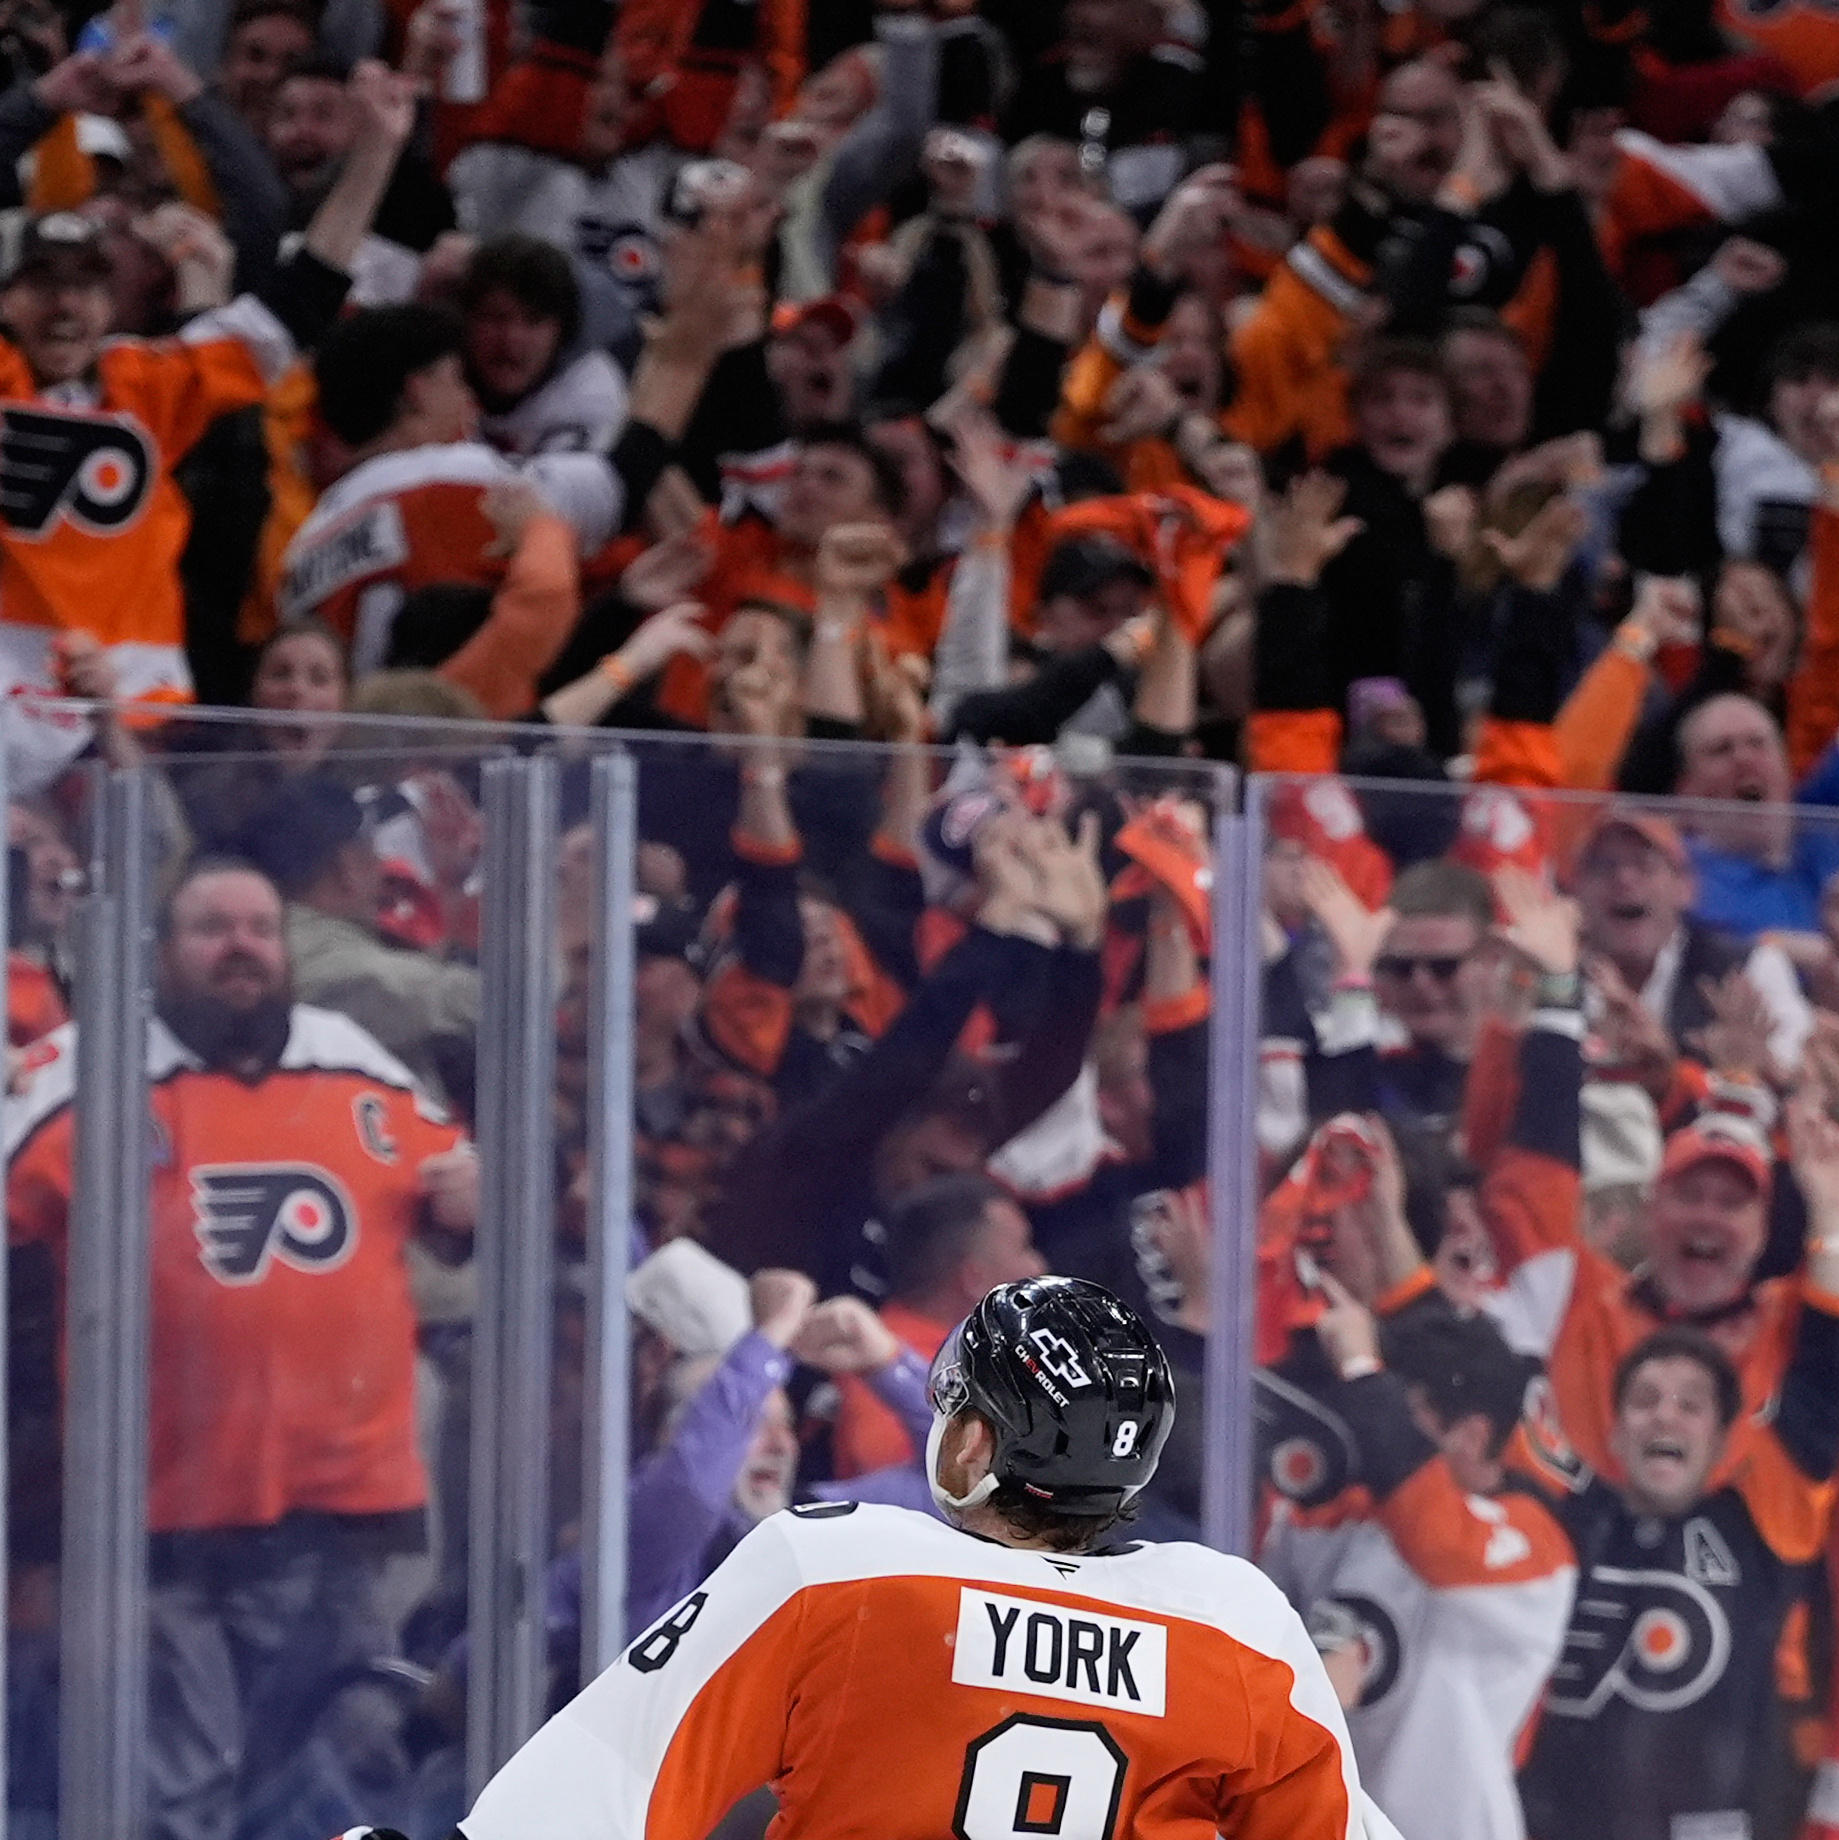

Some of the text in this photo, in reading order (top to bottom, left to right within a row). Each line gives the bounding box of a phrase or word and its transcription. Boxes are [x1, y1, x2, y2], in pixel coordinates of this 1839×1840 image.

[1014, 1344, 1071, 1408] CHEVROLET
[1112, 1420, 1138, 1457] 8
[1682, 1517, 1742, 1586] A
[628, 1591, 709, 1674] 8
[984, 1601, 1141, 1702] YORK
